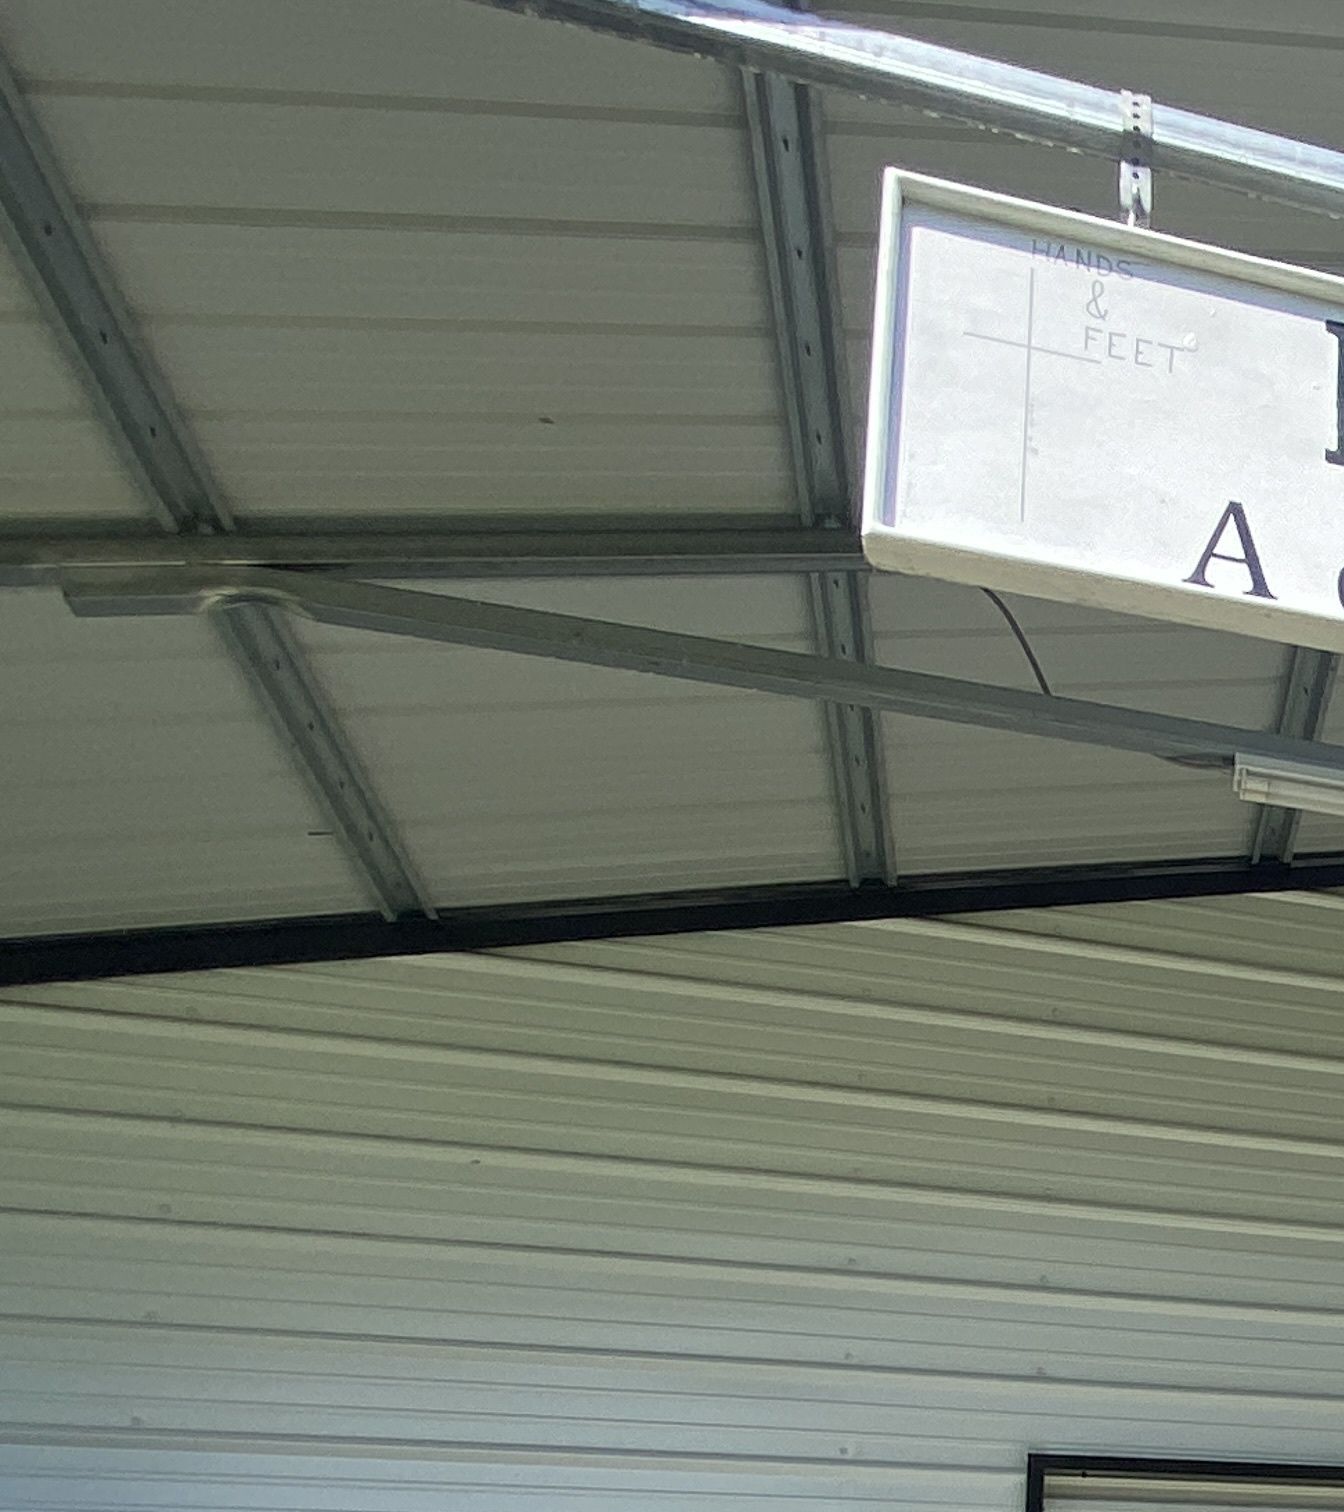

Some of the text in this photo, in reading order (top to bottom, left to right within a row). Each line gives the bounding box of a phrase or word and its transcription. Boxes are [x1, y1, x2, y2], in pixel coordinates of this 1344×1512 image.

[1030, 238, 1134, 280] HANDS
[1085, 279, 1110, 321] &
[1084, 326, 1184, 373] FEET
[1183, 501, 1277, 599] A
